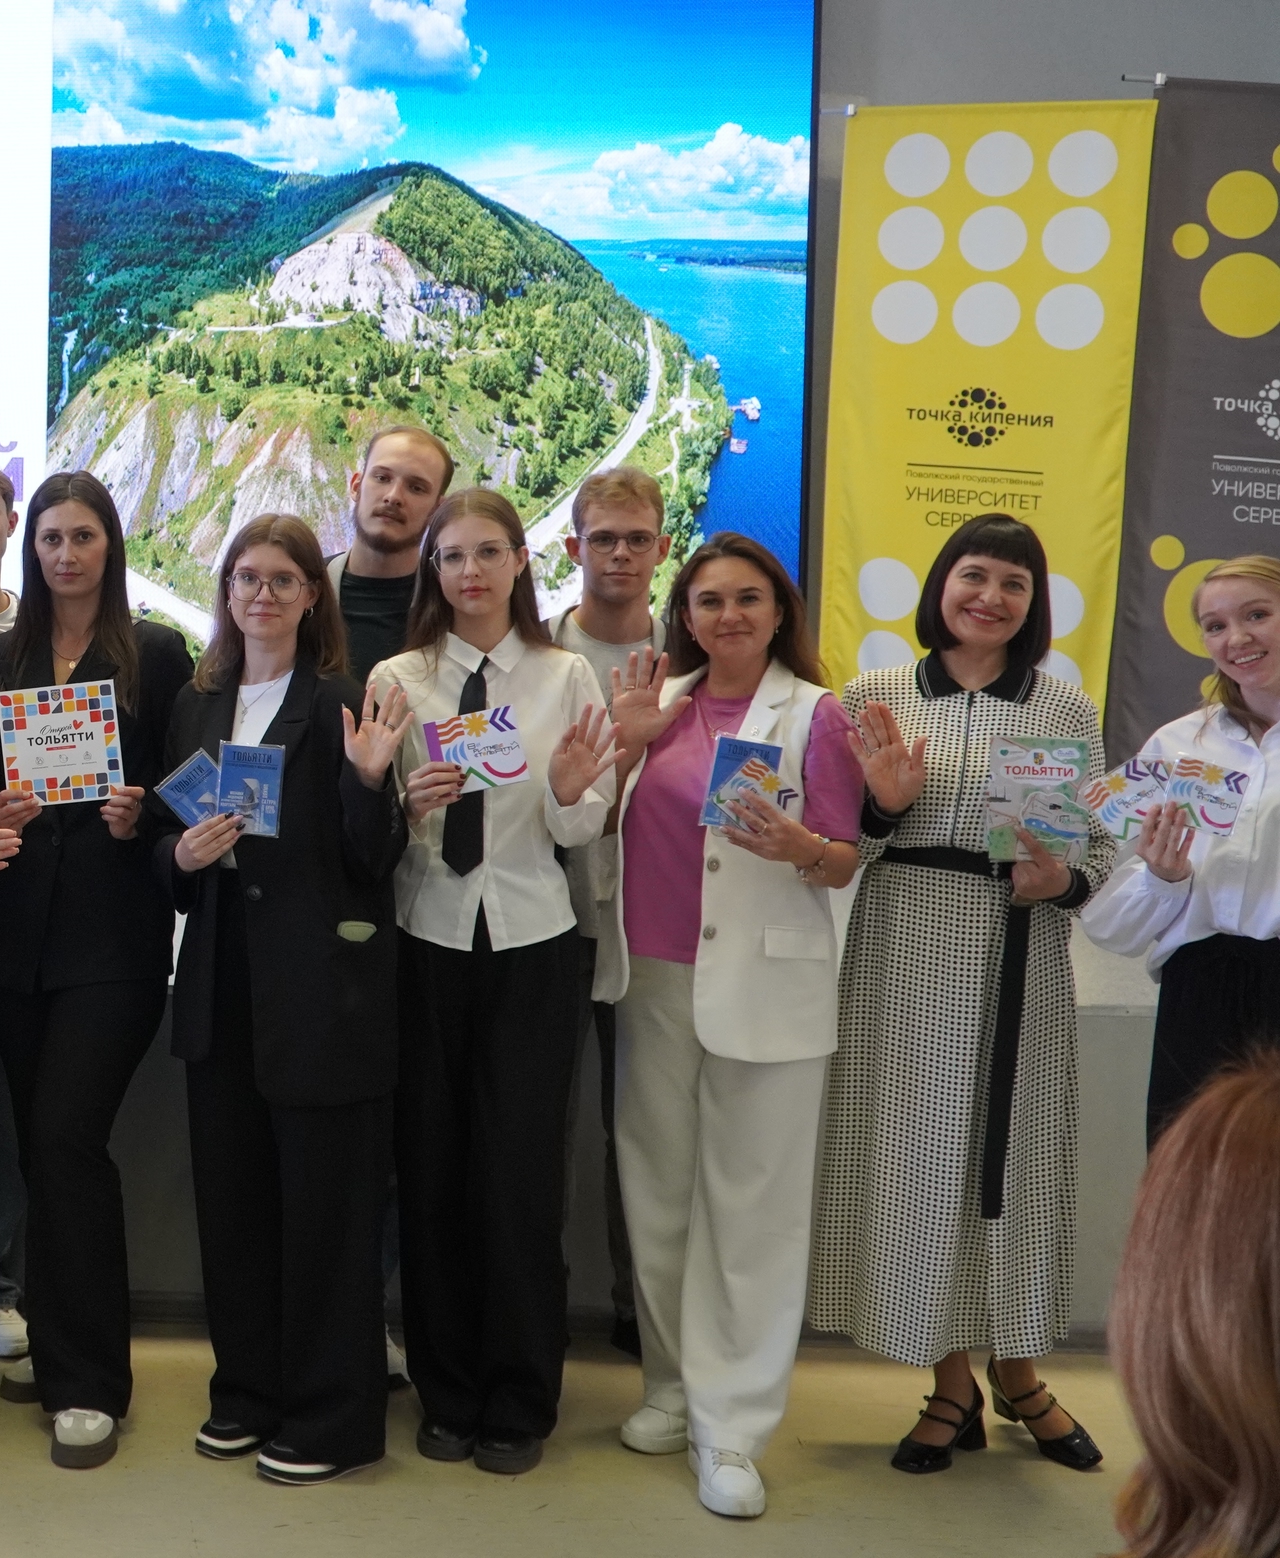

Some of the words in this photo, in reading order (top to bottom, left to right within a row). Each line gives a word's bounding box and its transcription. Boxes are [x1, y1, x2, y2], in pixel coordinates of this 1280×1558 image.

[1212, 461, 1270, 475] Поволжский
[906, 469, 960, 481] Поволжский
[962, 474, 1044, 487] государственный
[1211, 478, 1280, 500] УНИВЕ
[905, 485, 1042, 511] УНИВЕРСИТЕТ
[27, 731, 94, 747] ТОЛЬЯТТИ
[232, 750, 272, 764] ТОЛЬЯТТИ
[1004, 765, 1074, 777] ТОЛЬЯТТИ
[170, 764, 205, 796] ТОЛЬЯТТИ
